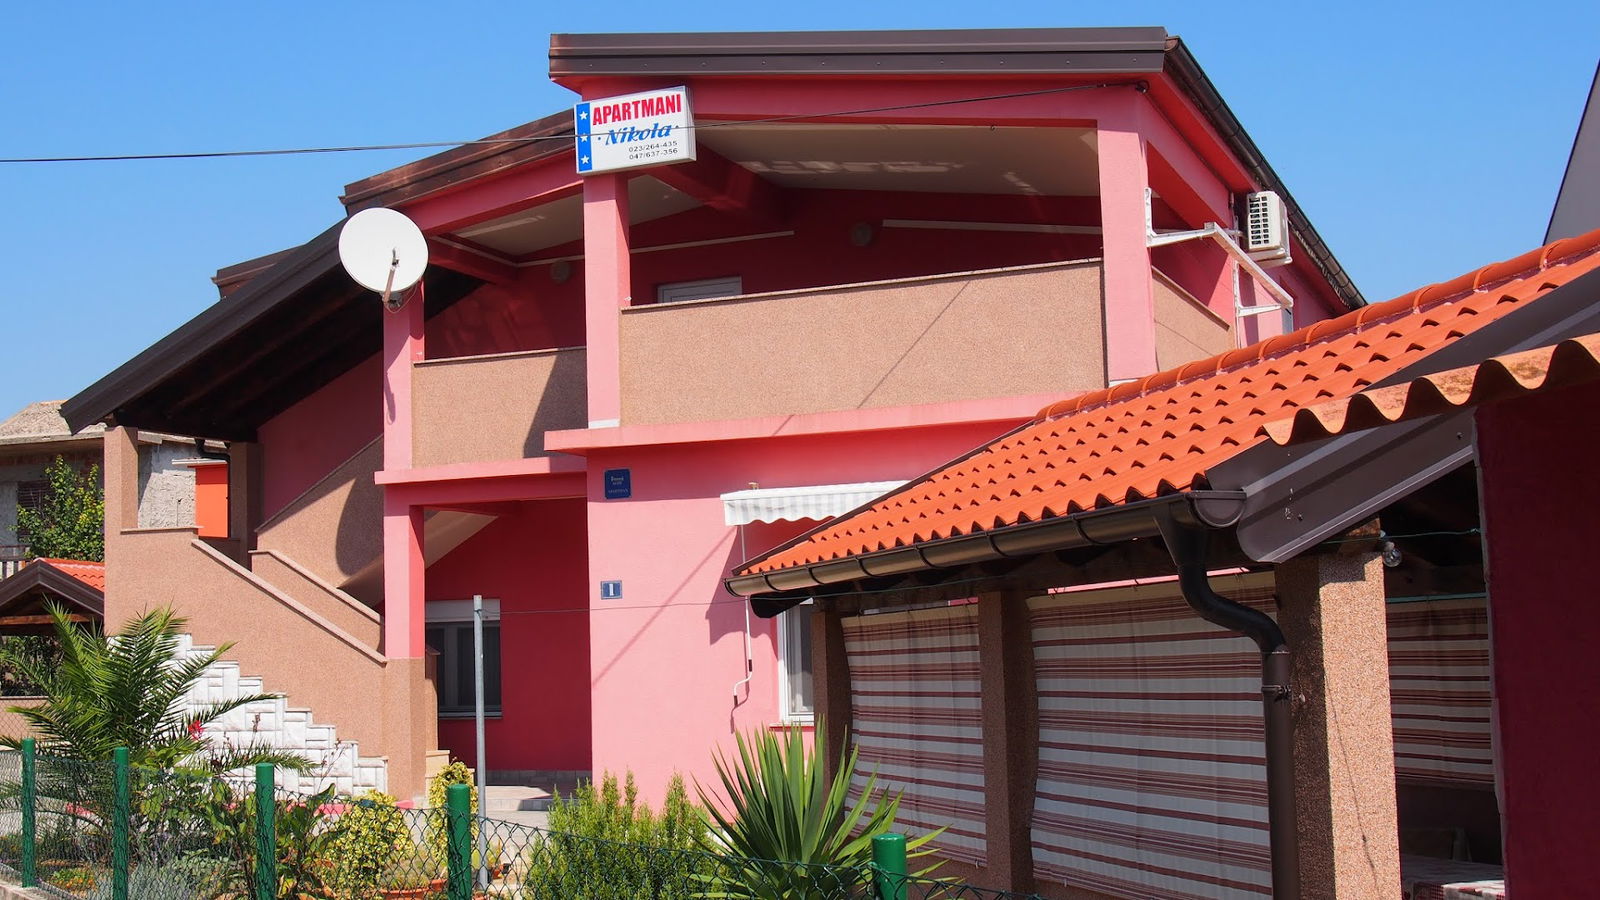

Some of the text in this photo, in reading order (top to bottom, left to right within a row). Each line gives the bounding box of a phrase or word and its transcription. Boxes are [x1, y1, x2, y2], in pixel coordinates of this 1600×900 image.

[592, 94, 682, 126] APARTMANI
[605, 123, 672, 146] Nikola
[628, 140, 678, 153] 023/264-435
[609, 583, 615, 596] 1
